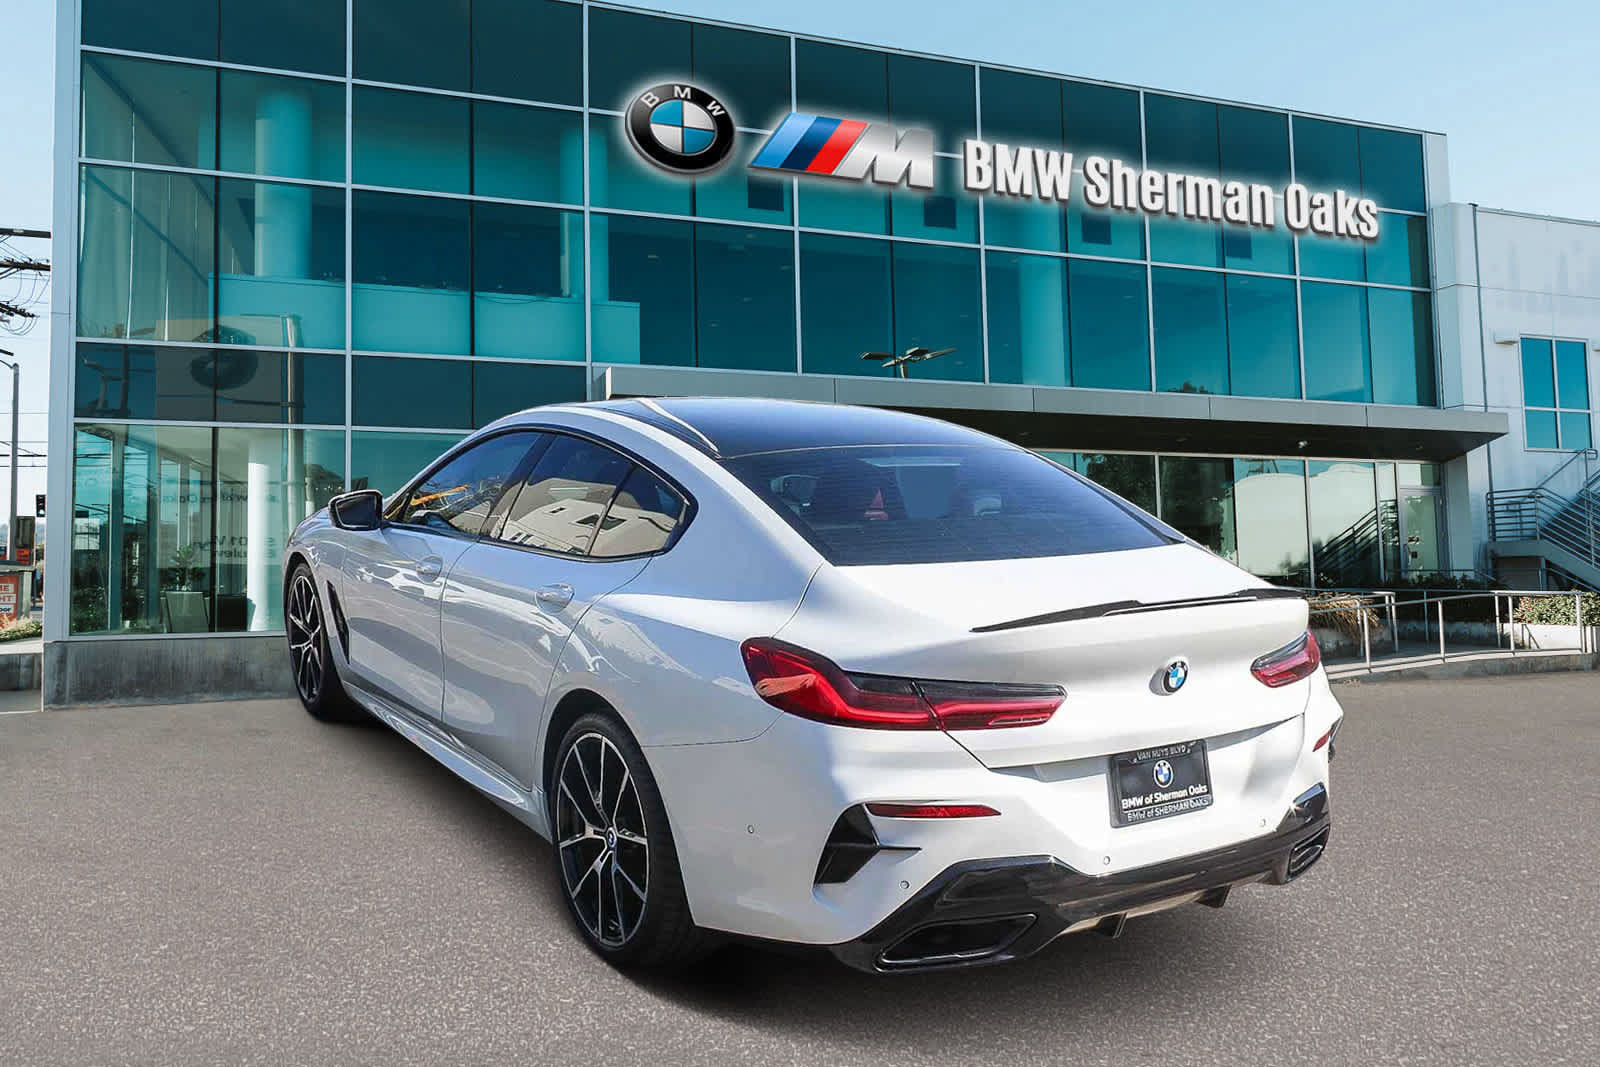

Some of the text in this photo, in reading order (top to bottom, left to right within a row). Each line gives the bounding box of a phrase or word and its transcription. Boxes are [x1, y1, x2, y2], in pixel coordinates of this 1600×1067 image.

[641, 85, 726, 119] BMW
[964, 138, 1380, 241] BMW Sherman Oaks
[1137, 751, 1151, 760] VAN
[1122, 784, 1208, 809] BMW of Sherman Oaks
[1128, 811, 1146, 821] BMW
[1147, 810, 1154, 818] of
[1155, 802, 1189, 816] SHERMAN
